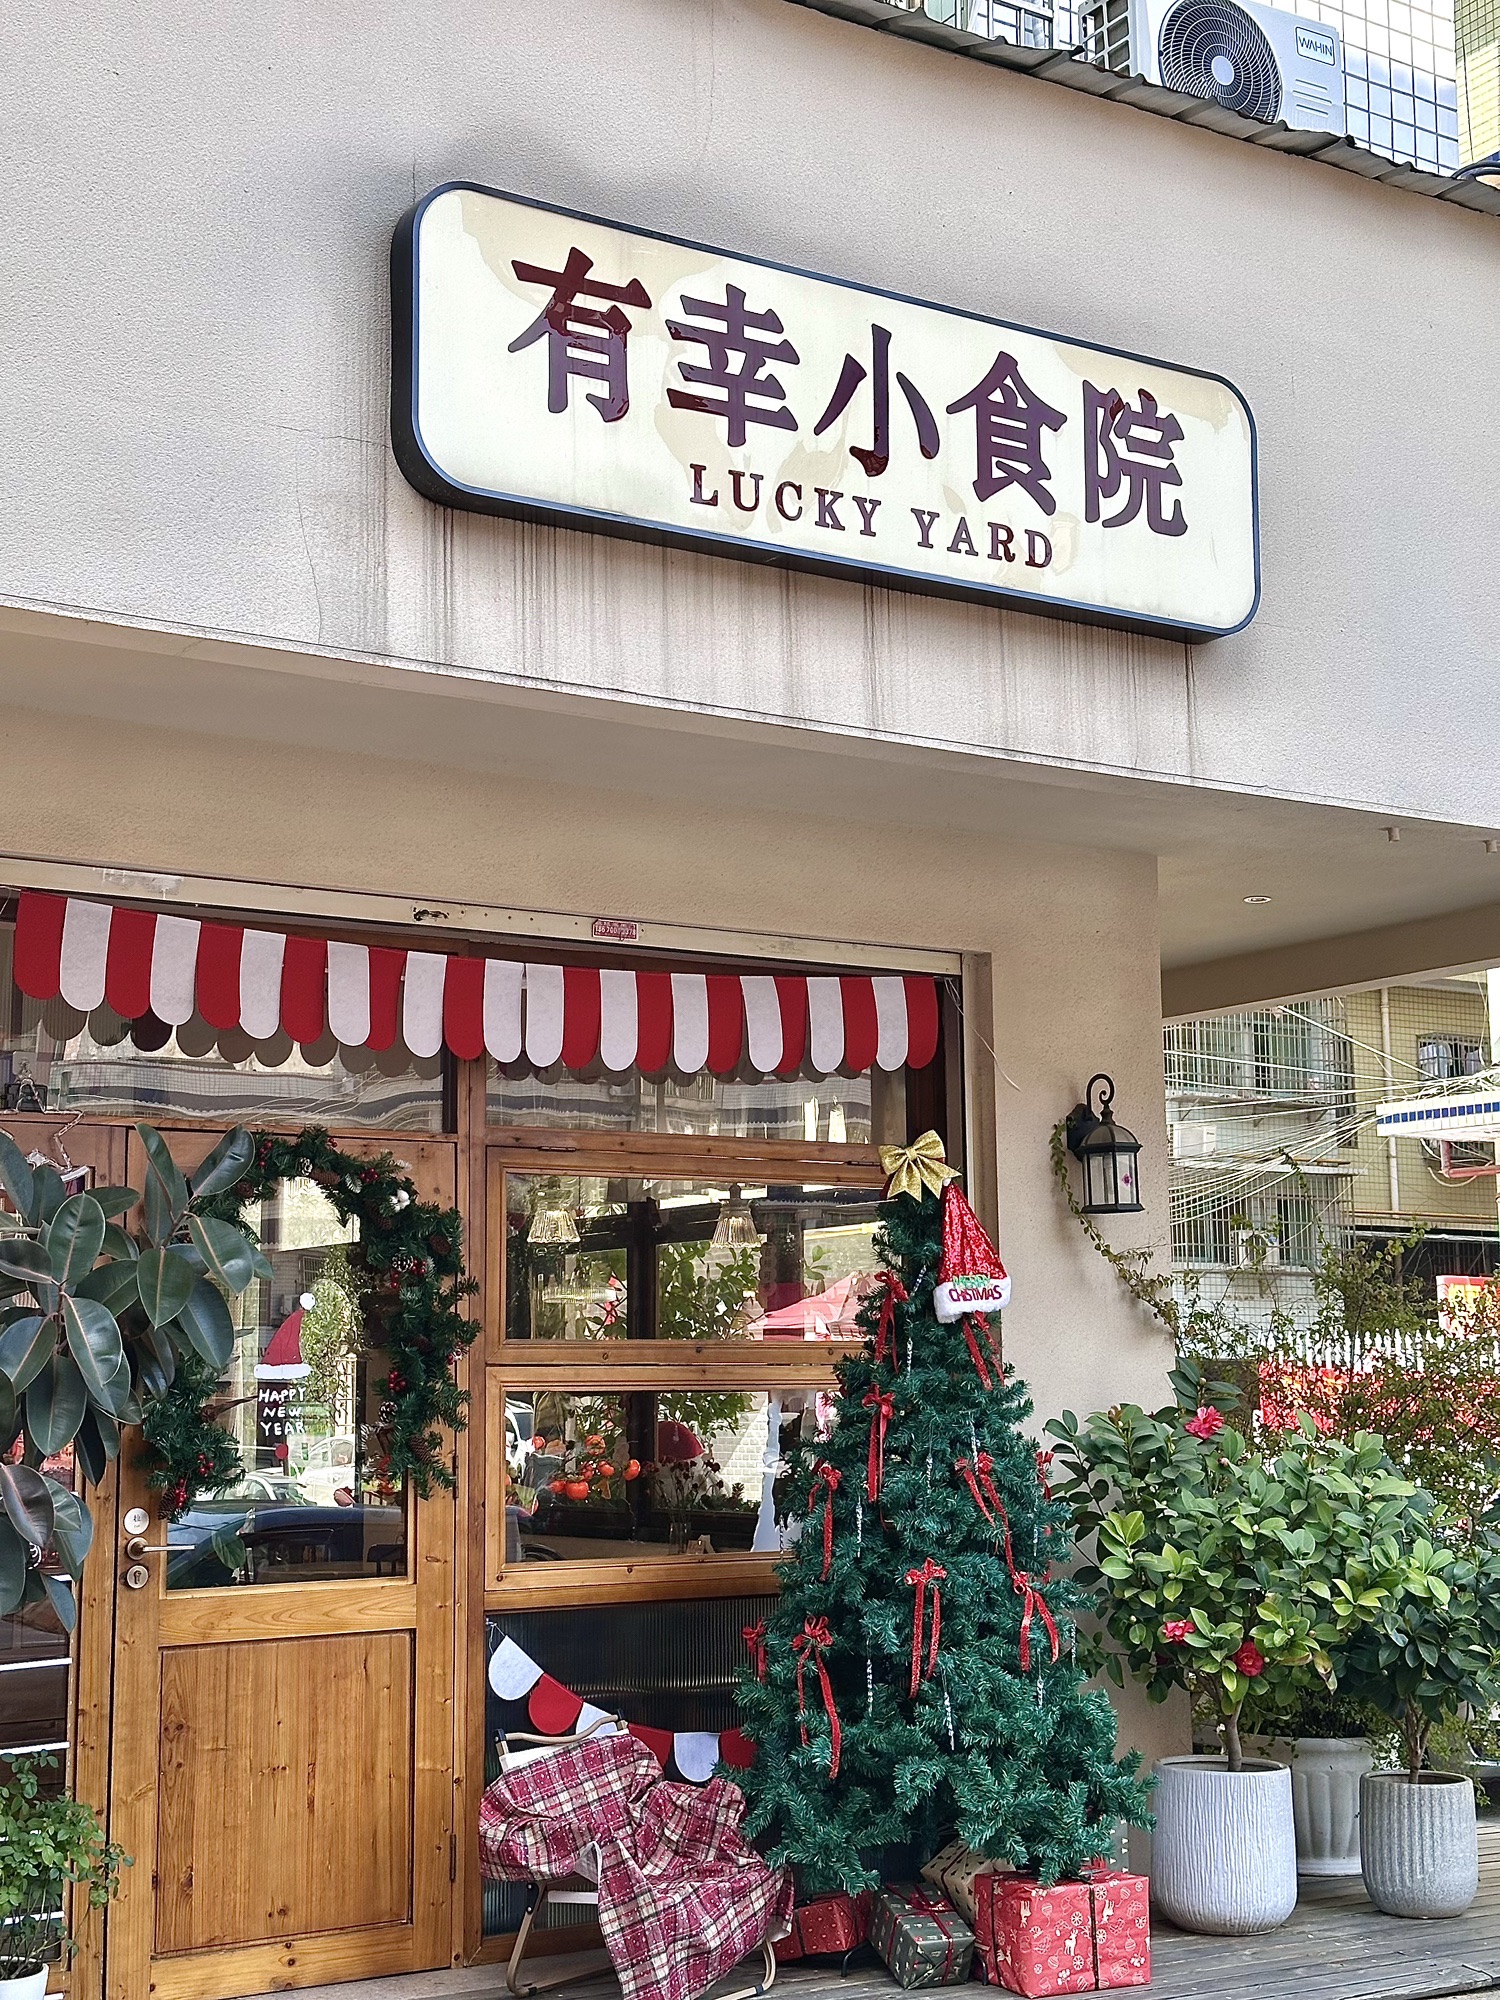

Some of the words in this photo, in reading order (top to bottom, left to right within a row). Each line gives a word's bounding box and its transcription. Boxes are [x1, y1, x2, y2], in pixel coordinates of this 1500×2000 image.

[1298, 36, 1332, 57] WAHIN
[507, 246, 1189, 537] 有幸小食院
[690, 463, 882, 537] LUCKY
[911, 508, 1053, 568] YARD
[259, 1387, 306, 1403] HAPPY
[263, 1407, 303, 1418] NEW
[260, 1420, 306, 1436] YEAR
